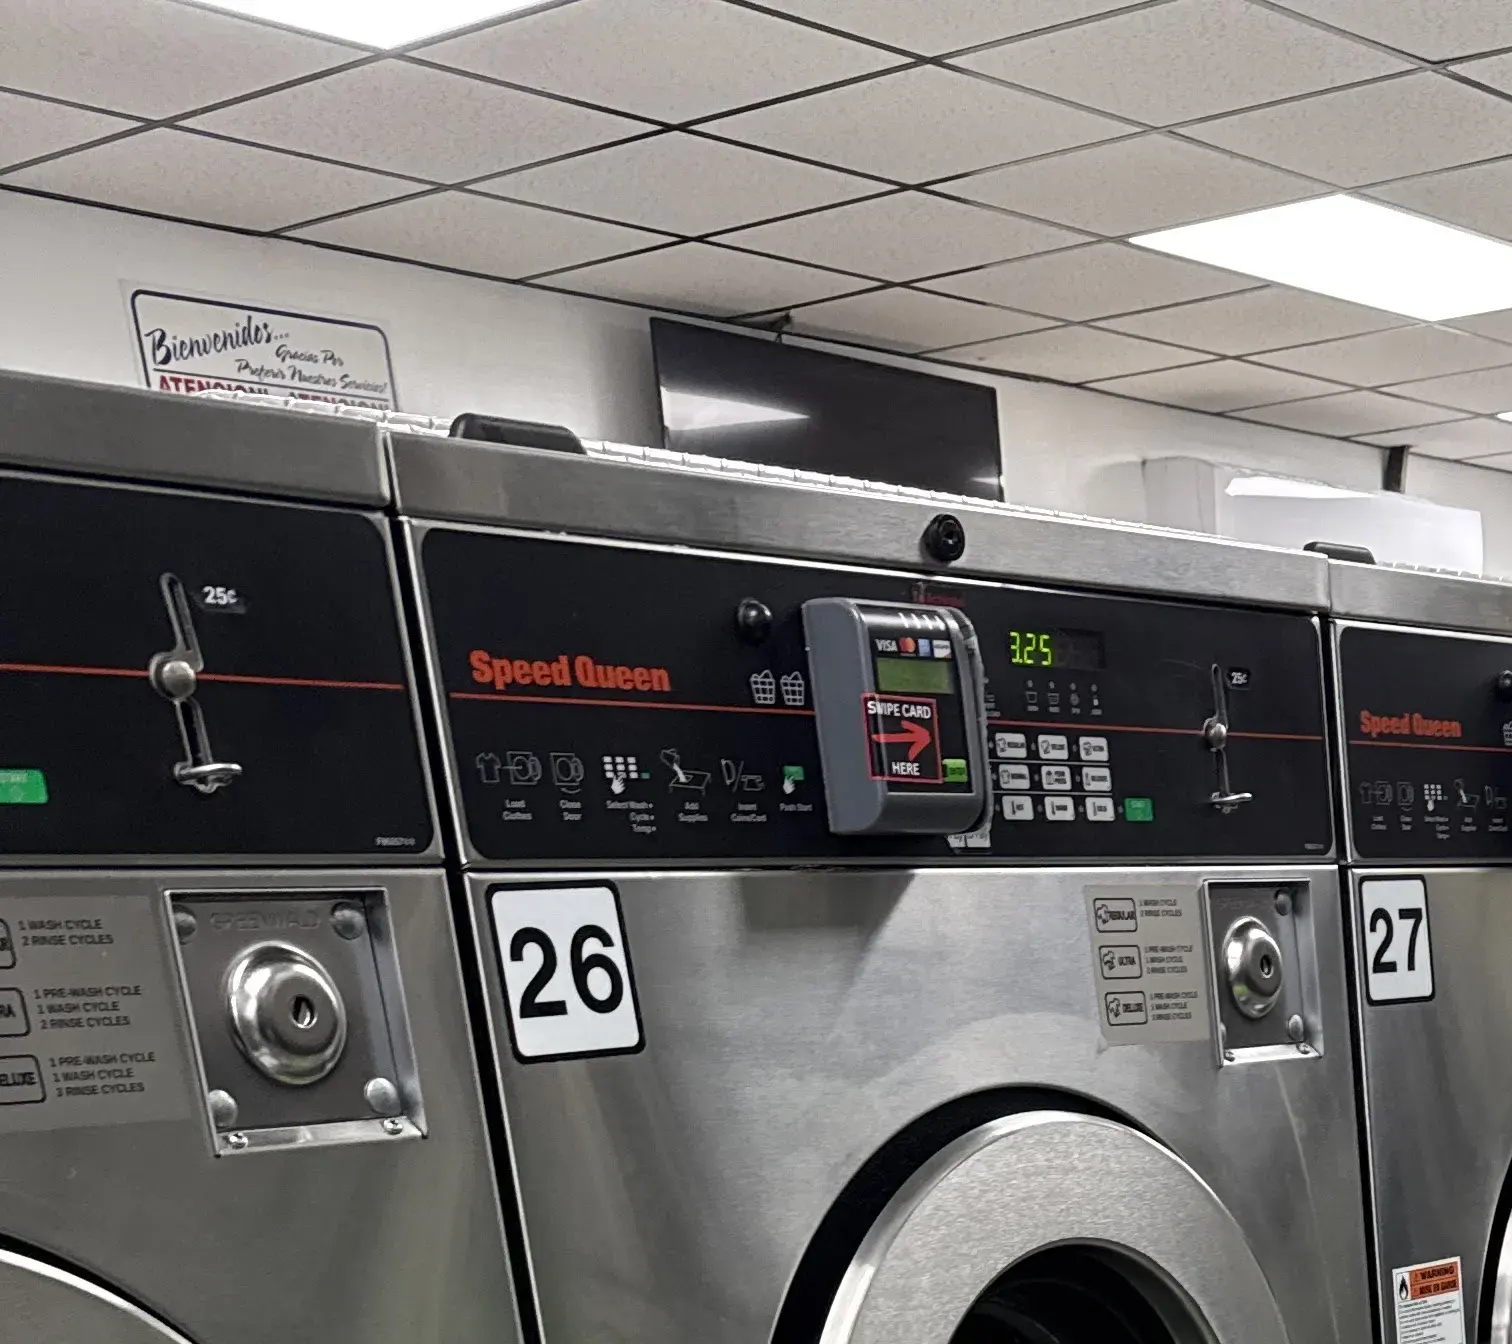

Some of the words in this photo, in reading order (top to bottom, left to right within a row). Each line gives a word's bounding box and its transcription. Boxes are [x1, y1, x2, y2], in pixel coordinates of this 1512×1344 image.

[275, 344, 318, 365] Gracias
[321, 350, 344, 367] Por
[874, 638, 898, 652] VISA
[1009, 631, 1052, 666] 3.25
[469, 649, 572, 691] Speed
[574, 655, 672, 692] Queen
[867, 700, 901, 717] SWIPE
[902, 703, 932, 719] CARD
[1360, 710, 1411, 738] Speed
[1412, 713, 1462, 738] Queen
[892, 760, 920, 776] HERE
[28, 919, 62, 930] WASH
[65, 919, 103, 930] CYCLE
[31, 935, 67, 946] RINSE
[69, 934, 114, 945] CYCLES
[1369, 907, 1423, 974] 27
[509, 924, 624, 1019] 26
[105, 985, 142, 996] CYCLE
[48, 1003, 80, 1013] WASH
[83, 1001, 120, 1012] CYCLE
[50, 1018, 85, 1028] RINSE
[86, 1016, 131, 1027] CYCLES
[119, 1052, 156, 1063] CYCLE
[63, 1071, 95, 1081] WASH
[98, 1068, 135, 1080] CYCLE
[65, 1085, 99, 1096] RINSE
[101, 1082, 145, 1094] CYCLES
